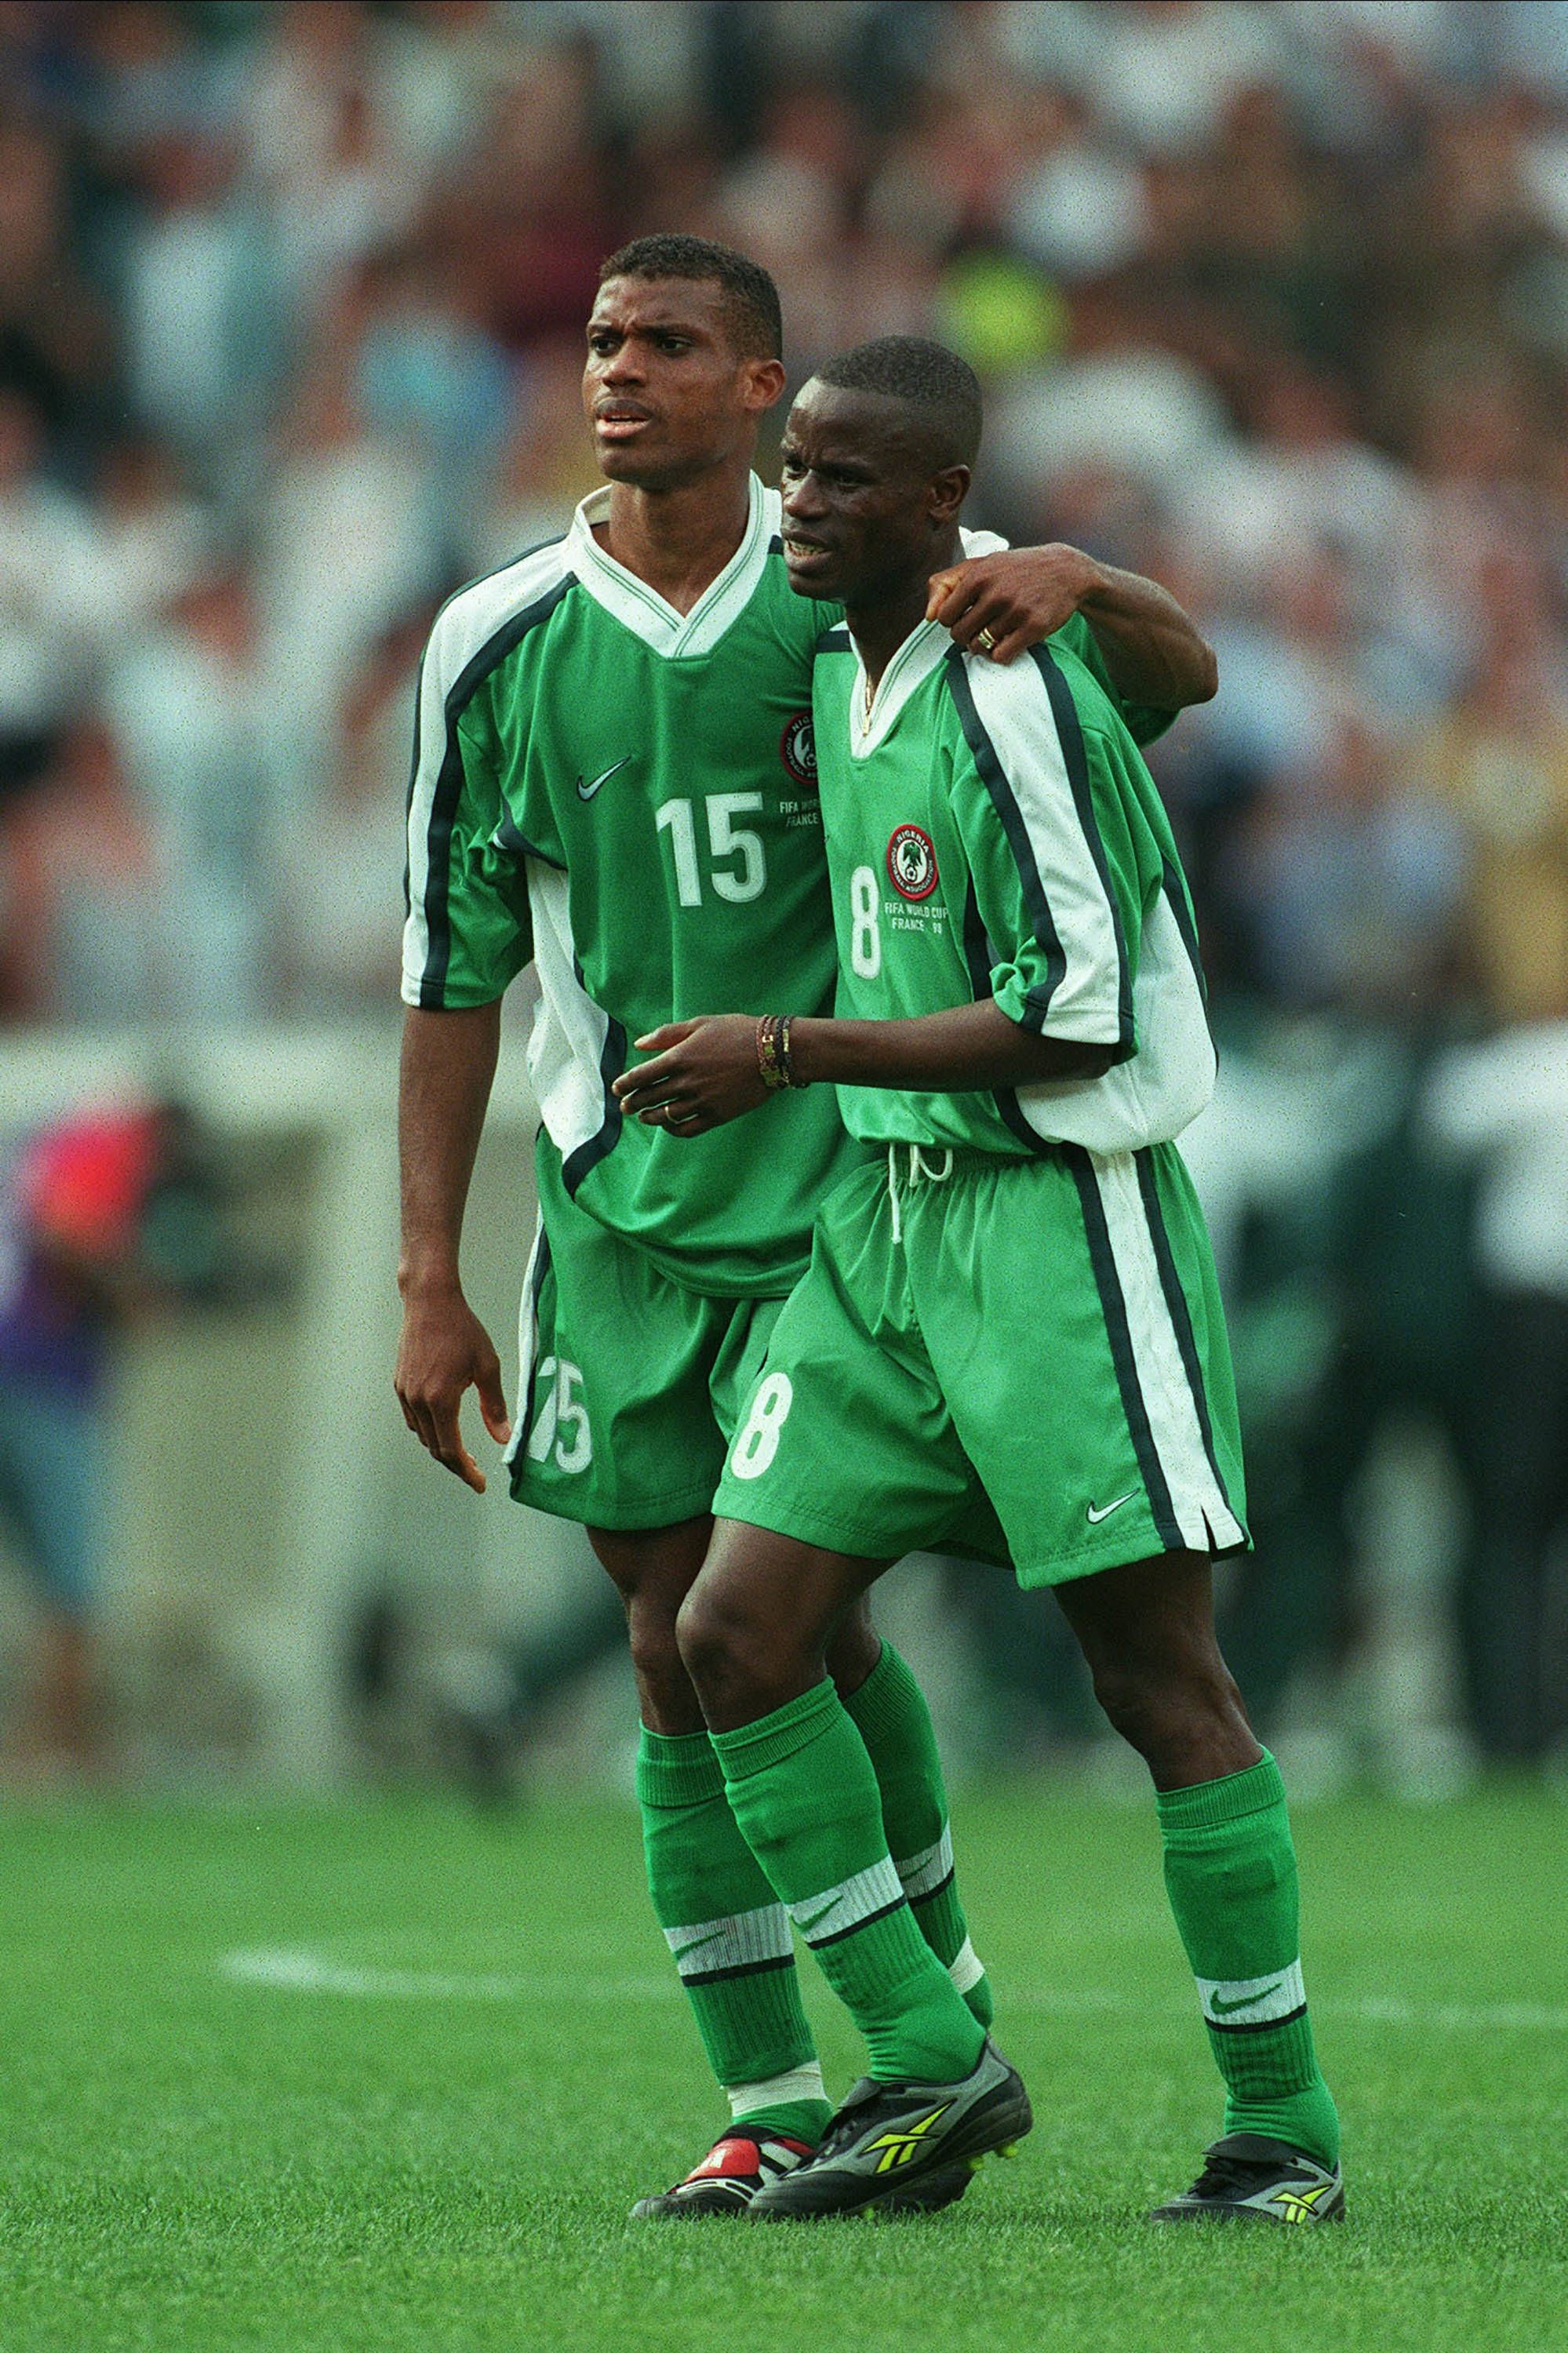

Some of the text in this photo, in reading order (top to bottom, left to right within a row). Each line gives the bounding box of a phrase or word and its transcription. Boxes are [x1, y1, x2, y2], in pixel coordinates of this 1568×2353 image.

[780, 801, 799, 814] FIFA
[786, 813, 819, 827] FRANCE
[655, 791, 768, 907] 15
[896, 829, 930, 853] NIGERIA
[850, 865, 882, 980] 8
[884, 902, 949, 919] FIFA WORLD CUP
[891, 917, 925, 932] FRANCE
[527, 1356, 593, 1475] 15
[730, 1372, 794, 1480] 8
